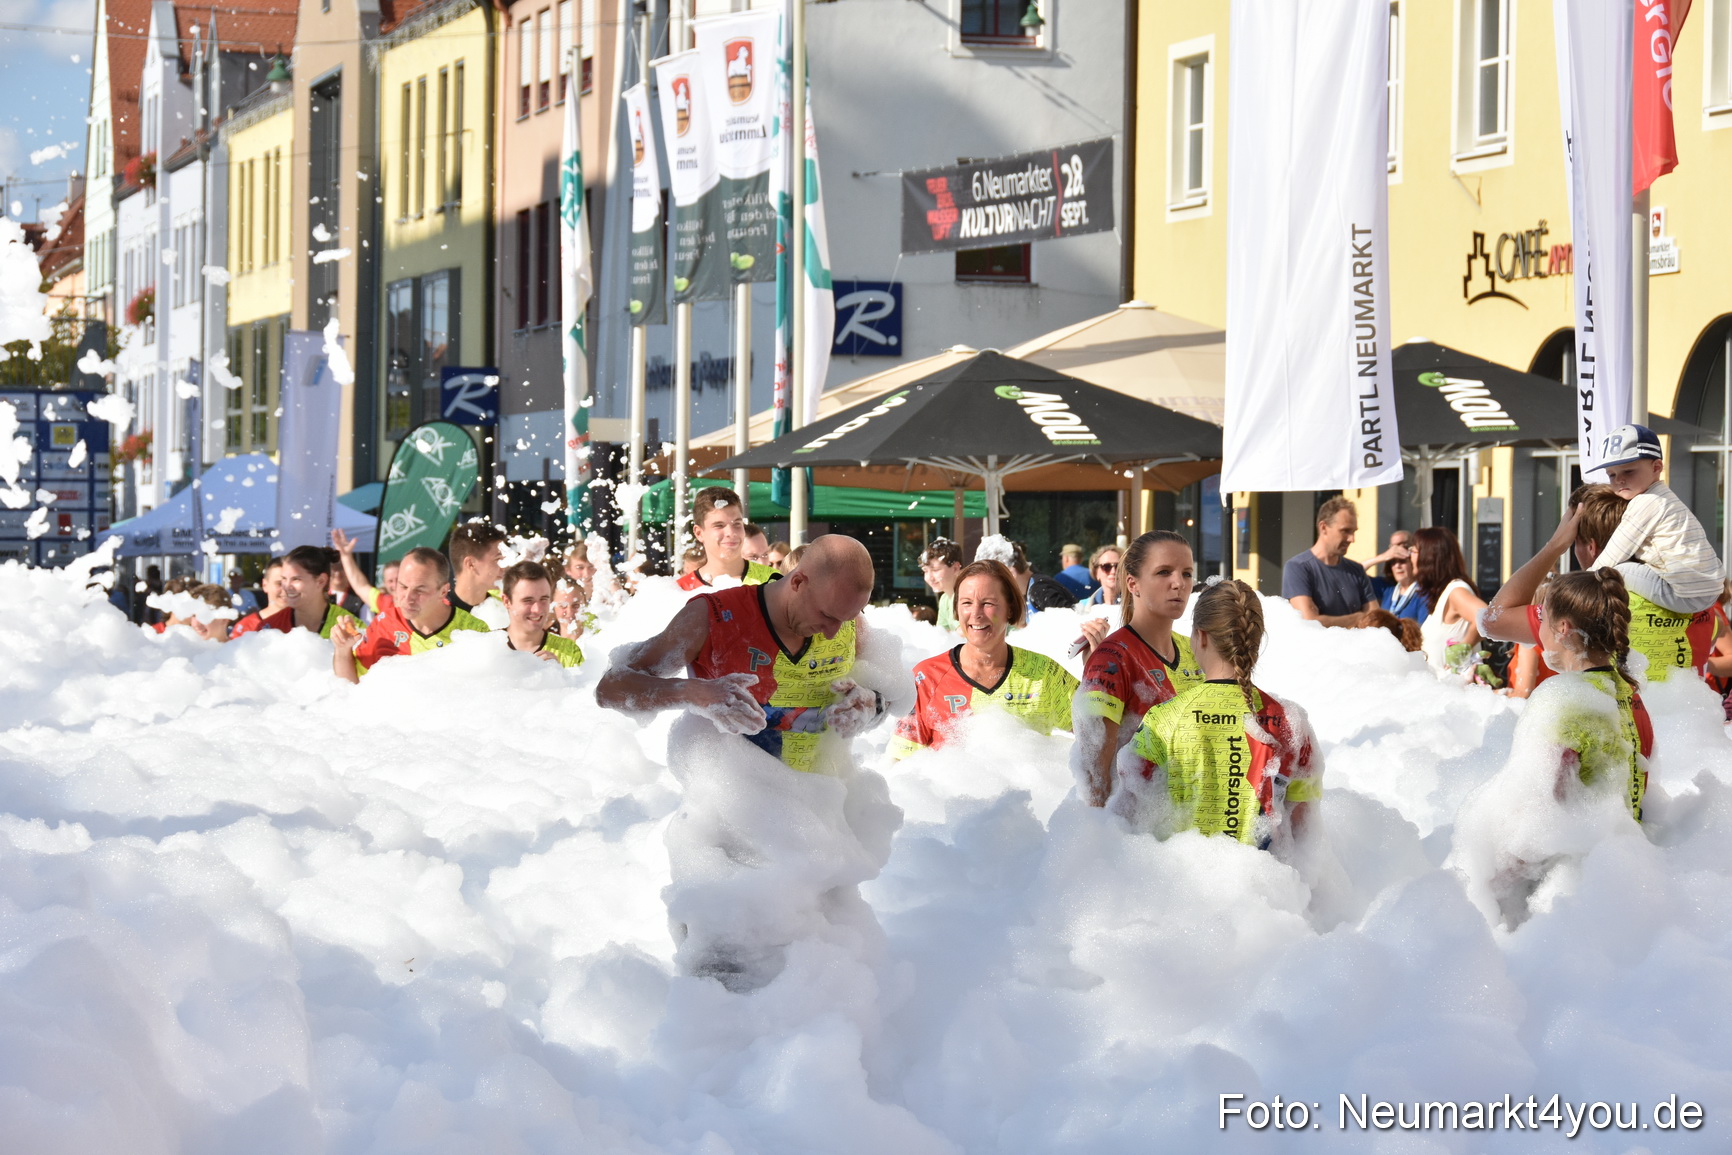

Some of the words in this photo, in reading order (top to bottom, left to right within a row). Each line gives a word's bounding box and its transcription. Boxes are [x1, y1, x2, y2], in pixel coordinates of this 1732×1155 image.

[1061, 154, 1085, 198] 28.
[960, 195, 1056, 238] KULTURNACHT
[1061, 200, 1089, 228] SEPT.
[835, 290, 898, 346] R.
[1352, 223, 1377, 377] NEUMARKT
[1358, 383, 1383, 468] PARTL
[421, 477, 461, 515] AOK
[379, 504, 424, 546] AOK
[1646, 614, 1684, 628] Team
[1192, 710, 1237, 725] Team
